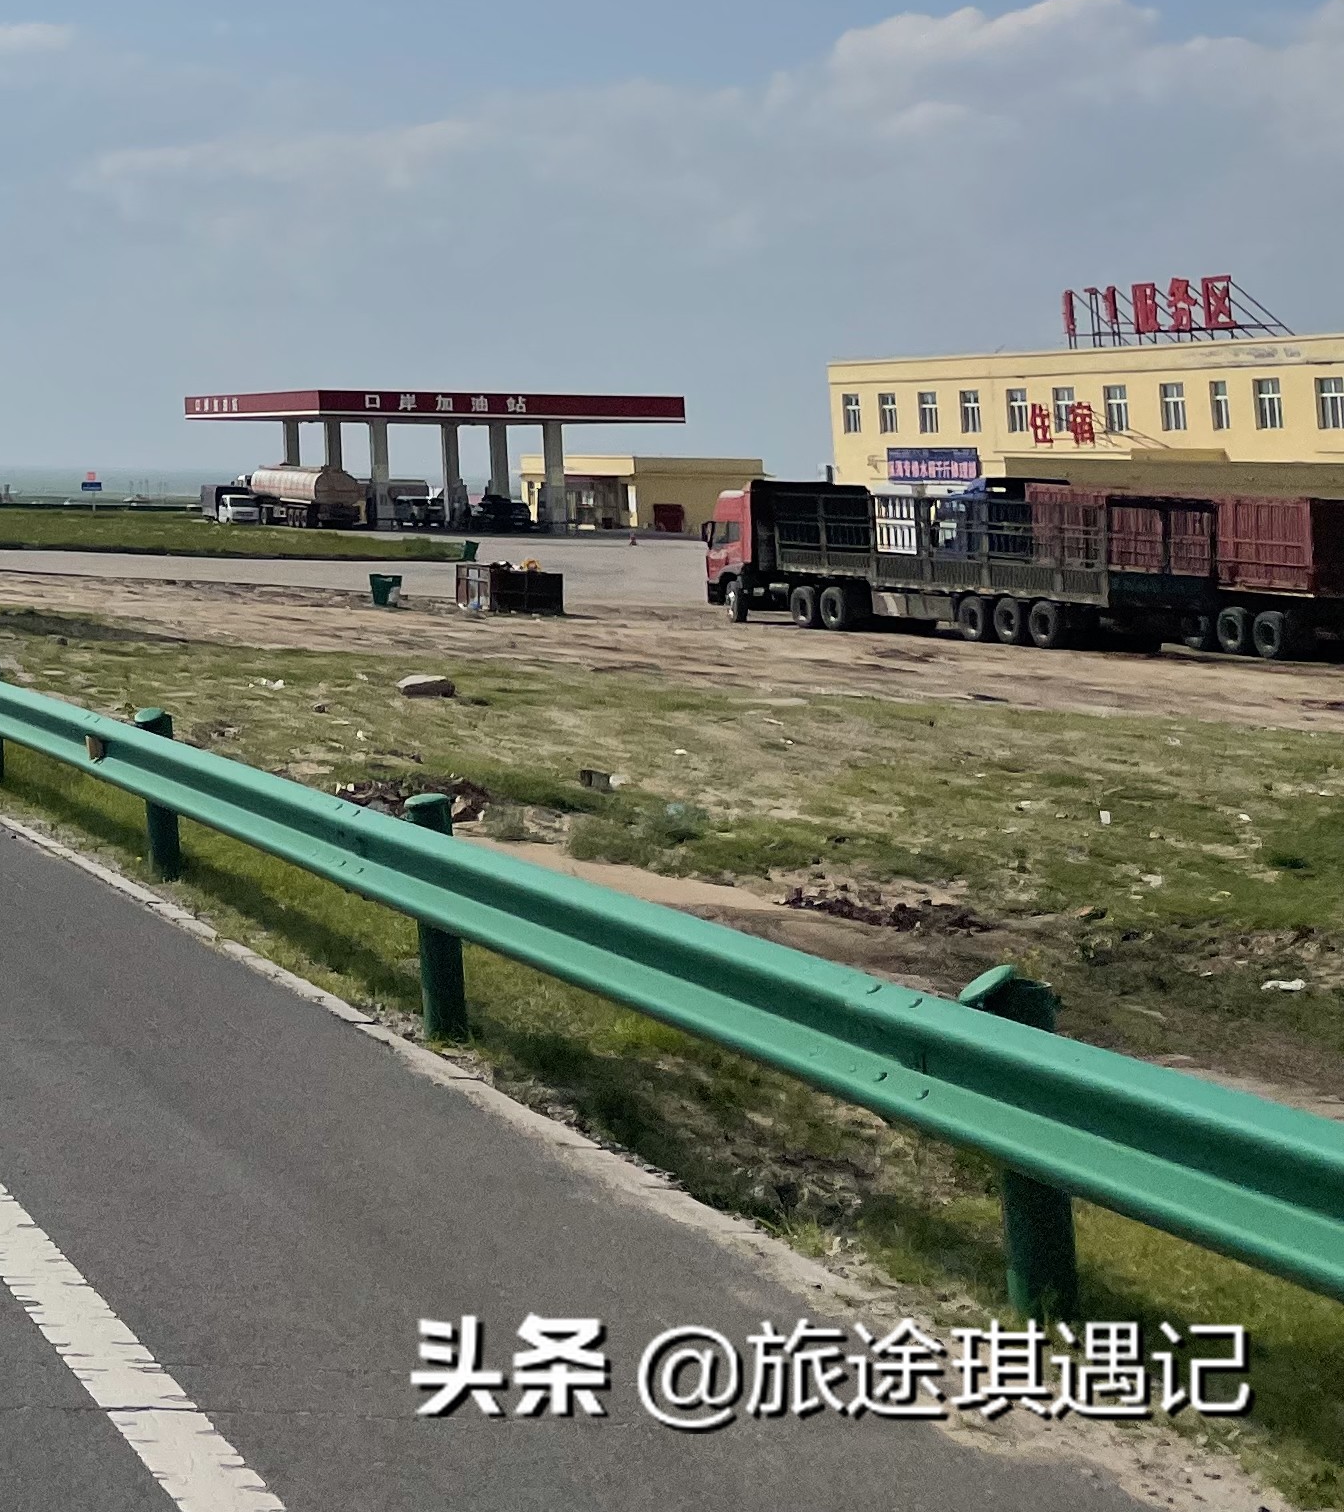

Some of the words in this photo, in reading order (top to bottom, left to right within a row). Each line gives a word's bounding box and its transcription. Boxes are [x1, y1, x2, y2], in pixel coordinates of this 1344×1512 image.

[364, 393, 528, 414] 口岸加油站
